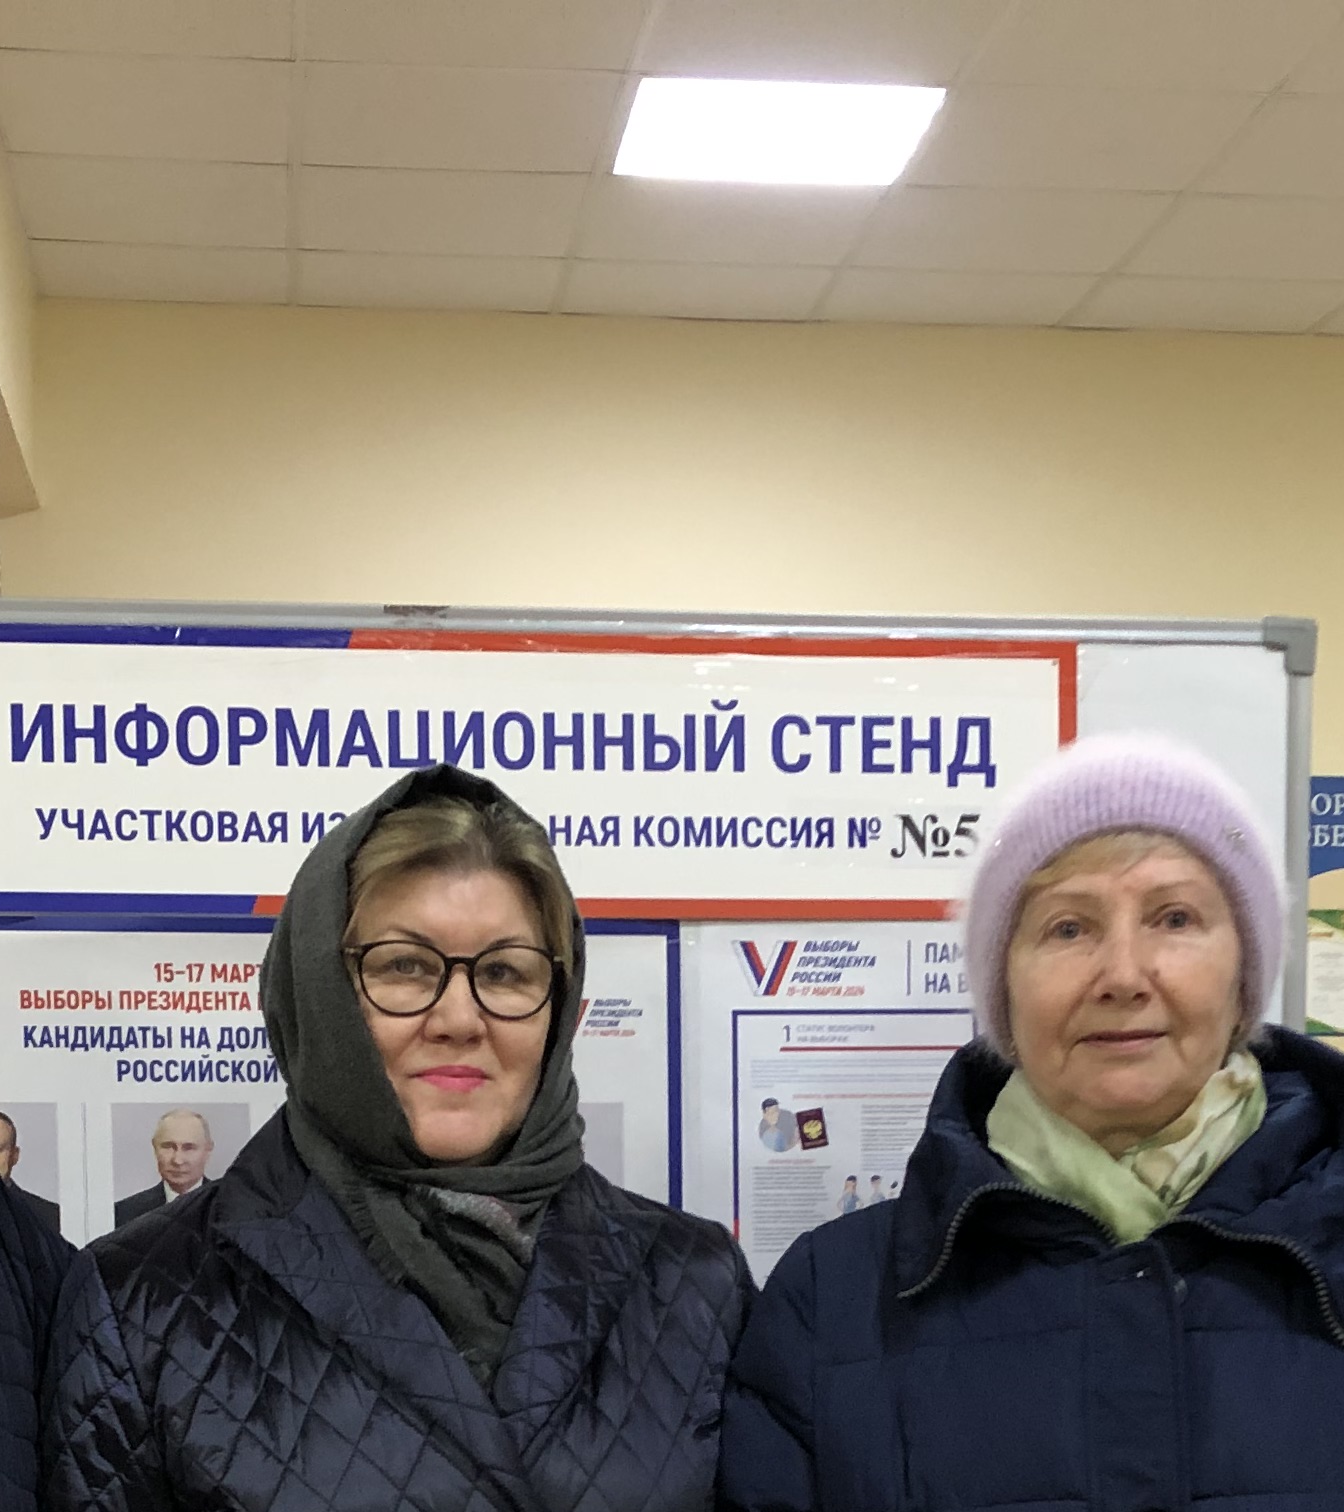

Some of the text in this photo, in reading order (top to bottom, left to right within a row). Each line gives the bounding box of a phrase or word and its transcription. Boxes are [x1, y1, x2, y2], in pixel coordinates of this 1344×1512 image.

[9, 698, 997, 788] ИНФОРМАЦИОННЫЙ СТЕНД
[34, 807, 289, 843] УЧАСТКОВАЯ
[633, 815, 835, 849] КОМИССИЯ
[803, 940, 861, 953] ВЫБОРЫ
[210, 962, 263, 984] МАР
[796, 955, 877, 970] ПРЕЗИДЕНТА
[790, 971, 843, 984] РОССИИ
[924, 972, 970, 994] НА В
[19, 989, 112, 1011] ВЫБОРЫ
[119, 990, 252, 1014] ПРЕЗИДЕНТА
[23, 1024, 272, 1053] КАНДИДАТЫ НА ДОЛ
[782, 1024, 792, 1043] 1
[116, 1053, 279, 1083] РОССИЙСКОЙ
